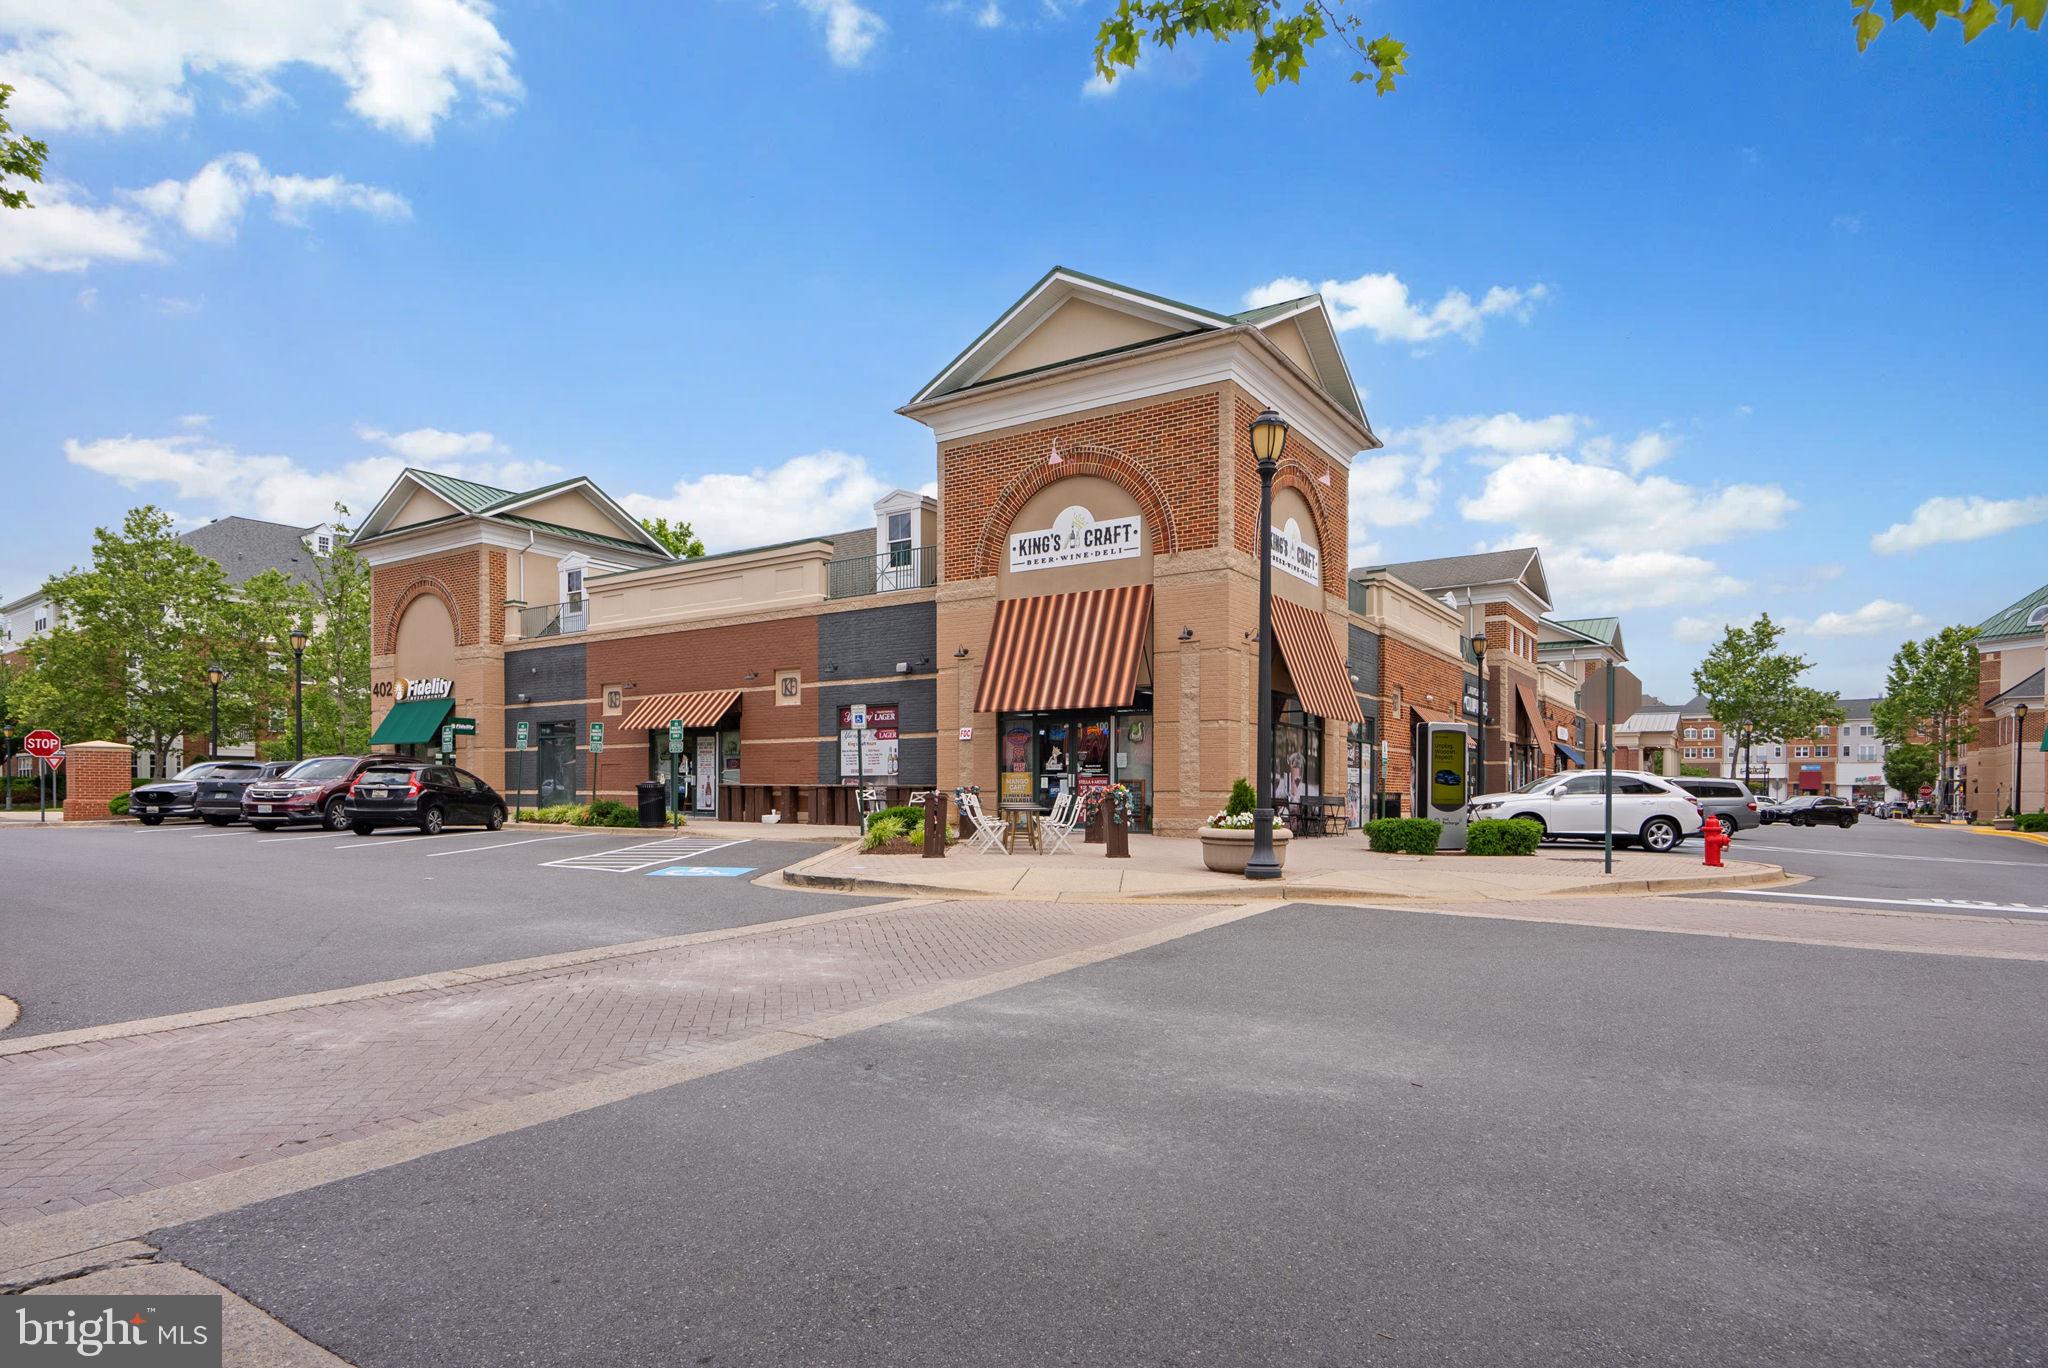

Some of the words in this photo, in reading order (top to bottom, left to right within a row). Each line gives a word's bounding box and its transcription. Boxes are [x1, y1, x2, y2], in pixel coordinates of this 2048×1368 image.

[1018, 533, 1061, 557] KING'S
[1083, 523, 1132, 547] CRAFT
[1296, 546, 1315, 571] CRAFT
[373, 681, 393, 698] 402
[407, 678, 453, 698] Fidelity
[874, 713, 896, 721] LAGER
[27, 738, 59, 749] STOP
